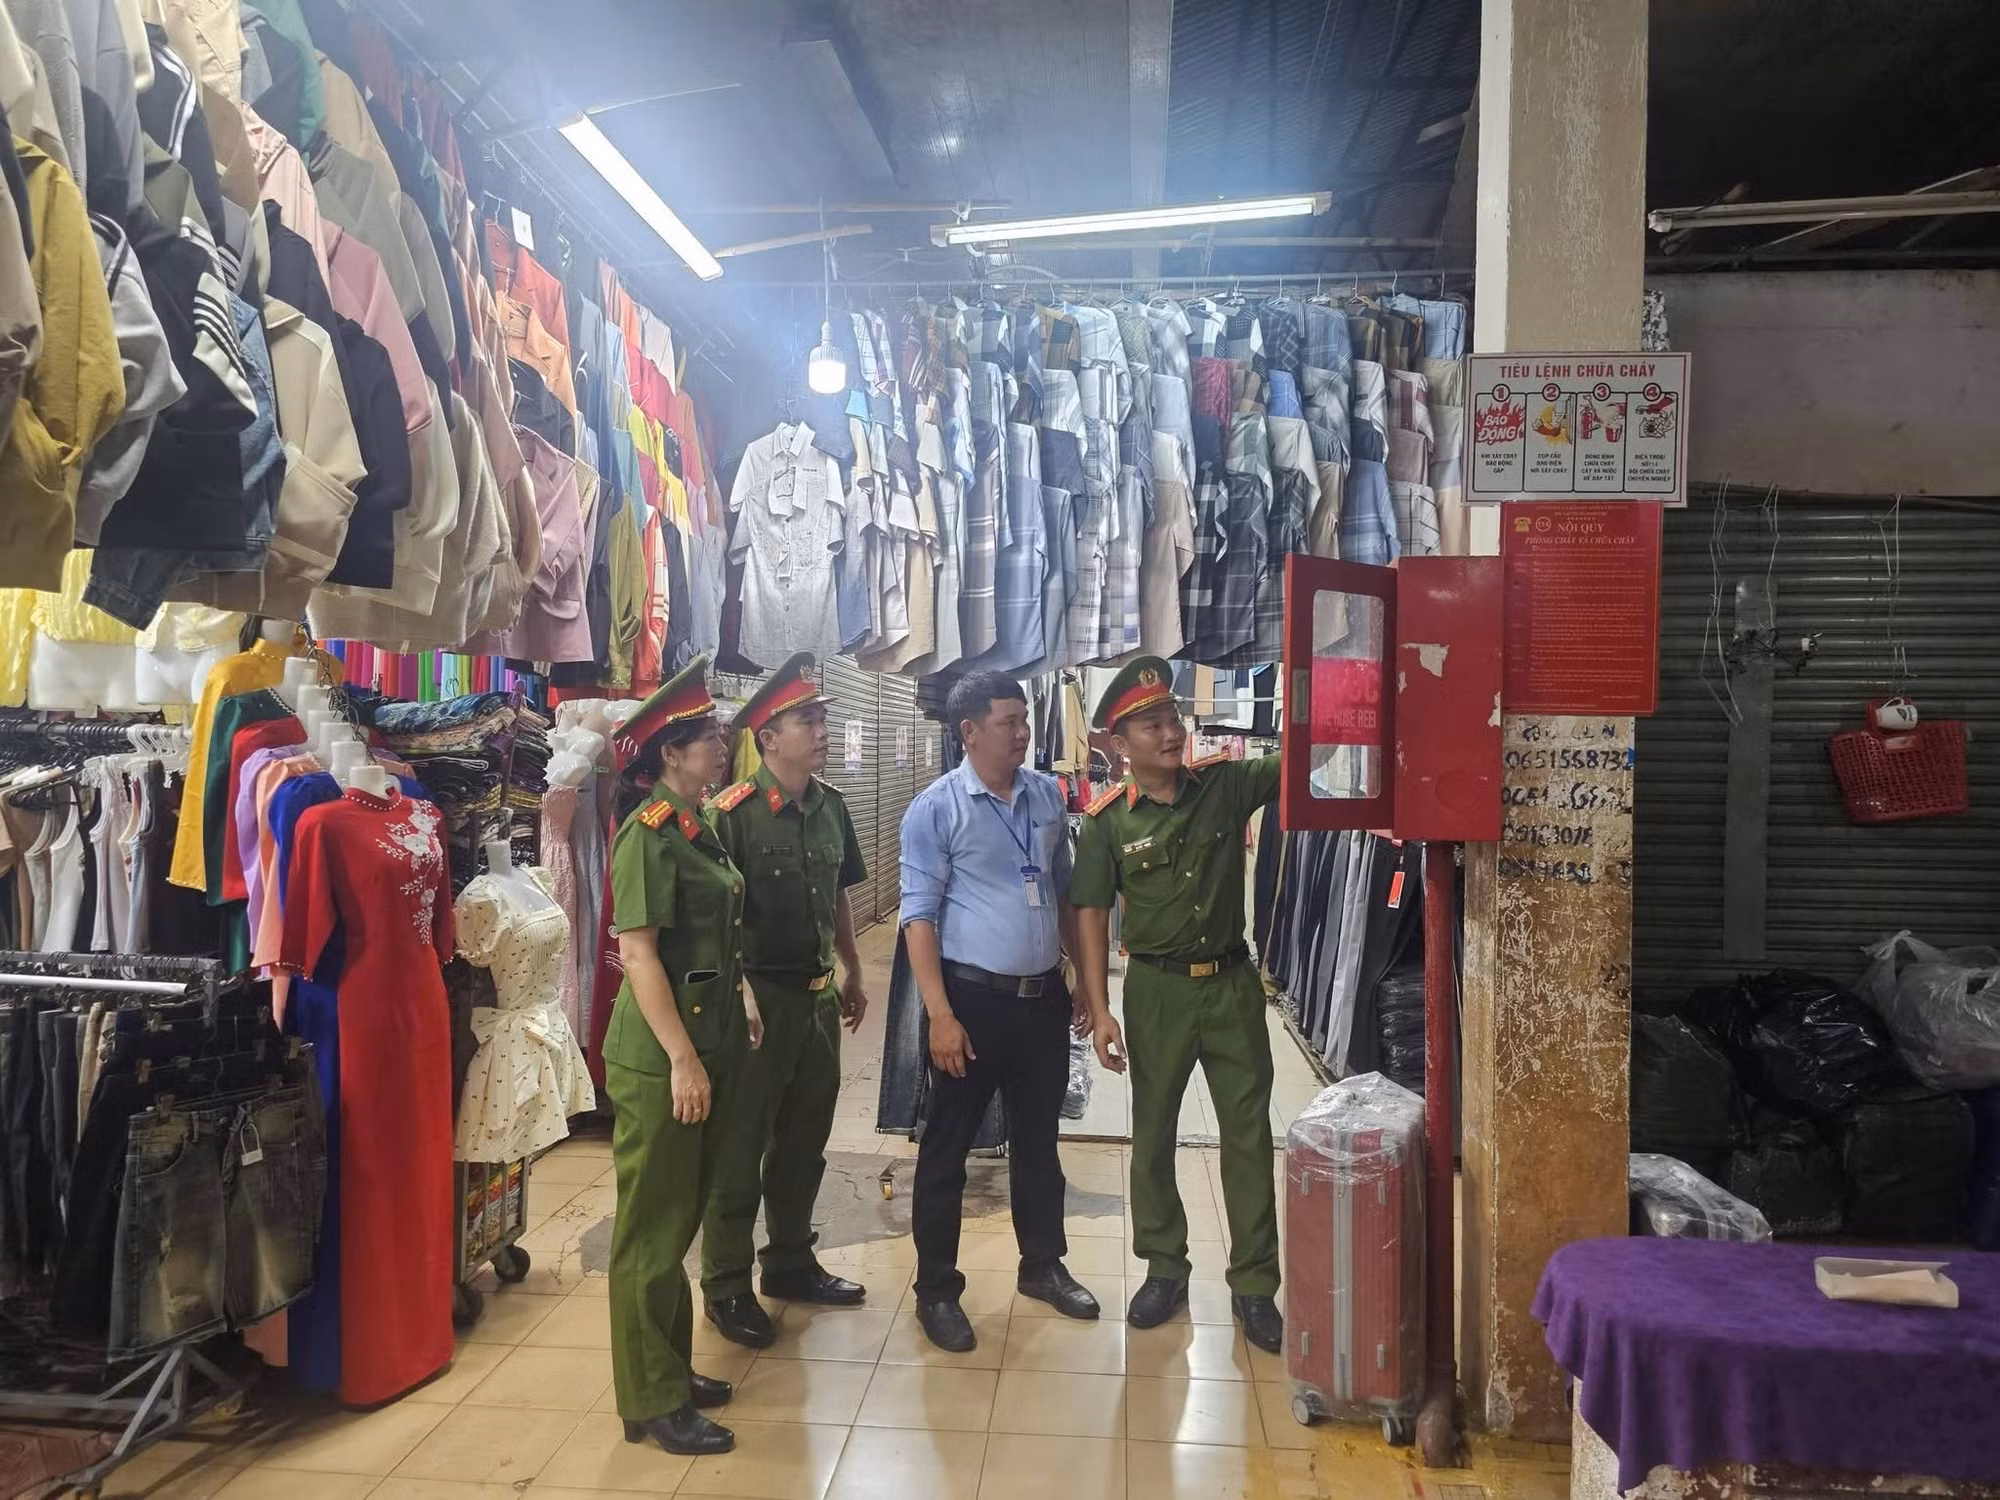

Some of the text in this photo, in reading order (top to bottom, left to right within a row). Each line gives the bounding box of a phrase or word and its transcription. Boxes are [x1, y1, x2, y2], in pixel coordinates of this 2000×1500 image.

[1500, 361, 1656, 381] TIÊU LỆNH CHỮA CHÁY
[1496, 387, 1504, 398] 1
[1546, 387, 1556, 398] 2
[1597, 386, 1607, 397] 3
[1646, 386, 1657, 397] 4
[1477, 426, 1517, 445] ĐỘNG
[1557, 520, 1578, 534] NỘI
[1554, 535, 1577, 544] CHÁY
[1579, 536, 1590, 544] VÀ
[1590, 535, 1612, 544] CHỮA
[1613, 535, 1635, 544] CHÁY
[1334, 709, 1355, 727] HOSE
